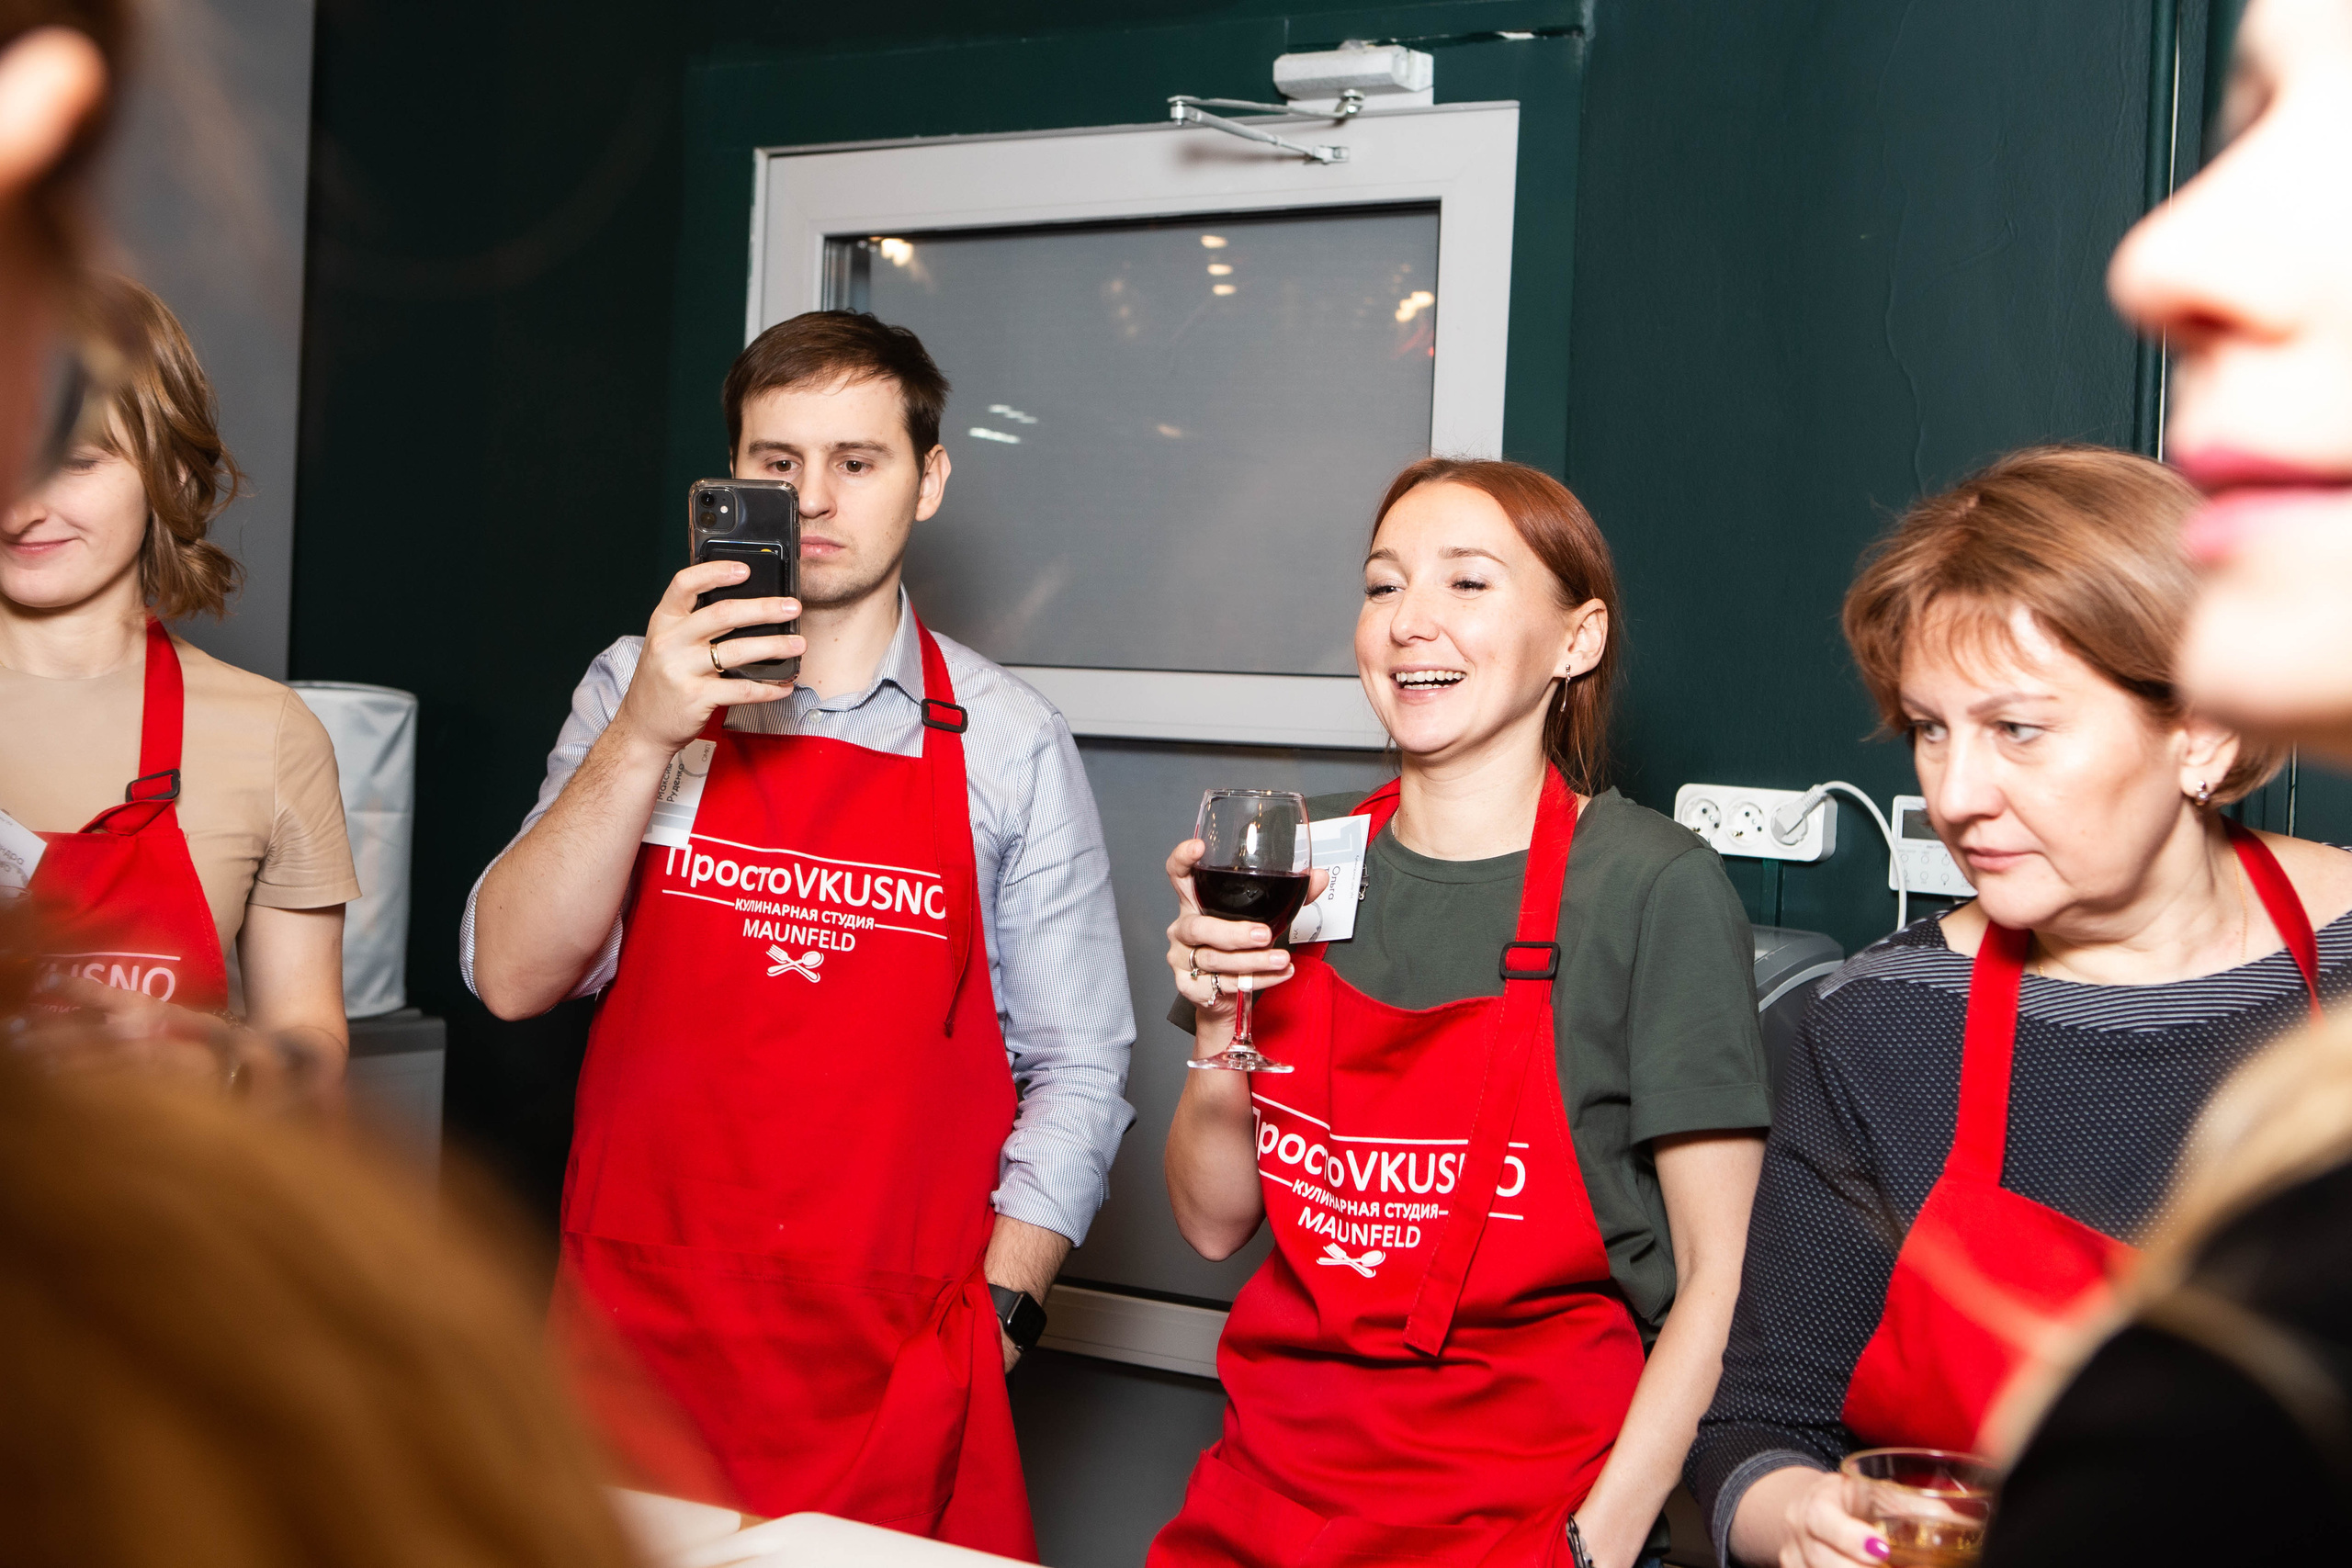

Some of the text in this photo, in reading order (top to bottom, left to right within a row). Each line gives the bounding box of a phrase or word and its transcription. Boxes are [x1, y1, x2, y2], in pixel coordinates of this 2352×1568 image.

[667, 763, 684, 803] Руденко
[1328, 865, 1340, 901] Ольга
[735, 897, 875, 931] КУЛИНАРНАЯ СТУДИЯ
[742, 919, 855, 952] MAUNFELD
[1292, 1179, 1439, 1222] КУЛИНАРНАЯ СТУДИЯ
[1297, 1206, 1421, 1248] MAUNFELD
